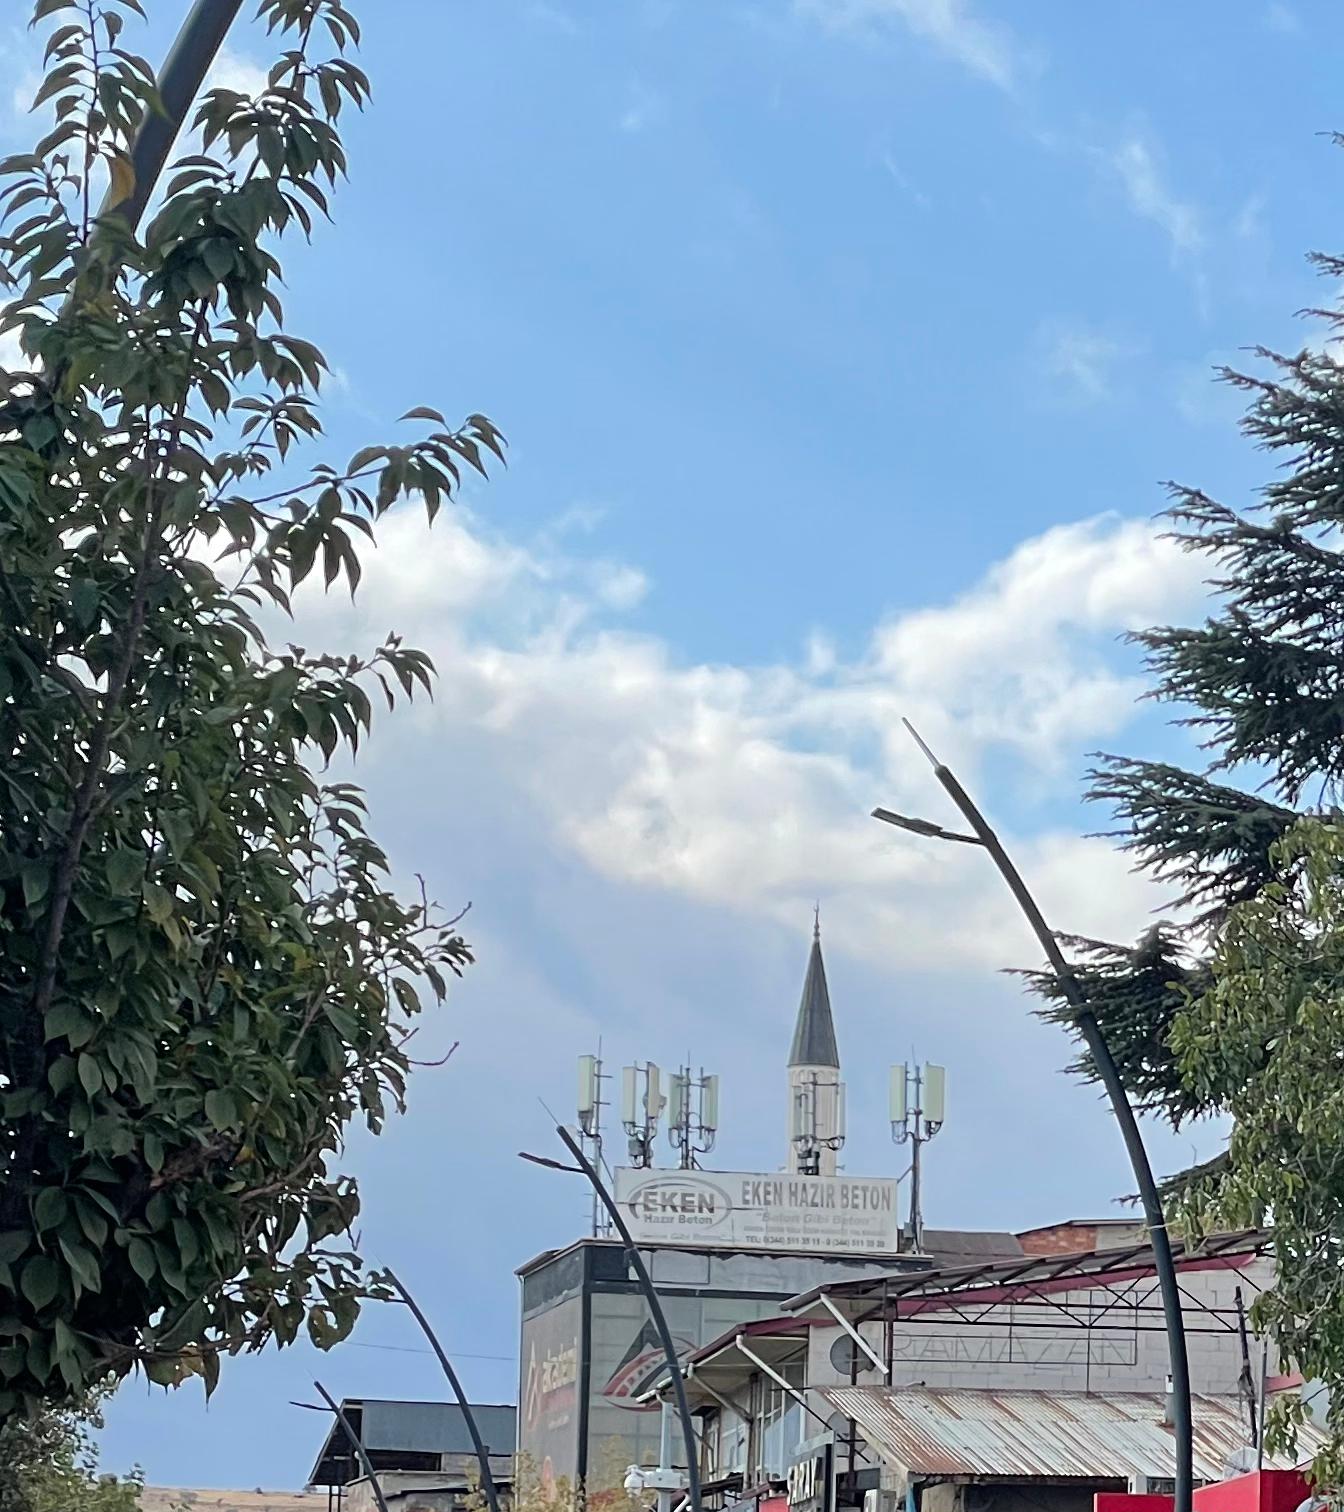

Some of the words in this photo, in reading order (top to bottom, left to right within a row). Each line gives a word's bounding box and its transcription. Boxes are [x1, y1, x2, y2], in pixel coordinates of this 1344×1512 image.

[645, 1191, 715, 1214] EKEN
[742, 1181, 784, 1206] EKEN
[788, 1183, 836, 1209] HAZIR
[841, 1185, 891, 1212] BETON
[678, 1215, 713, 1226] Beton
